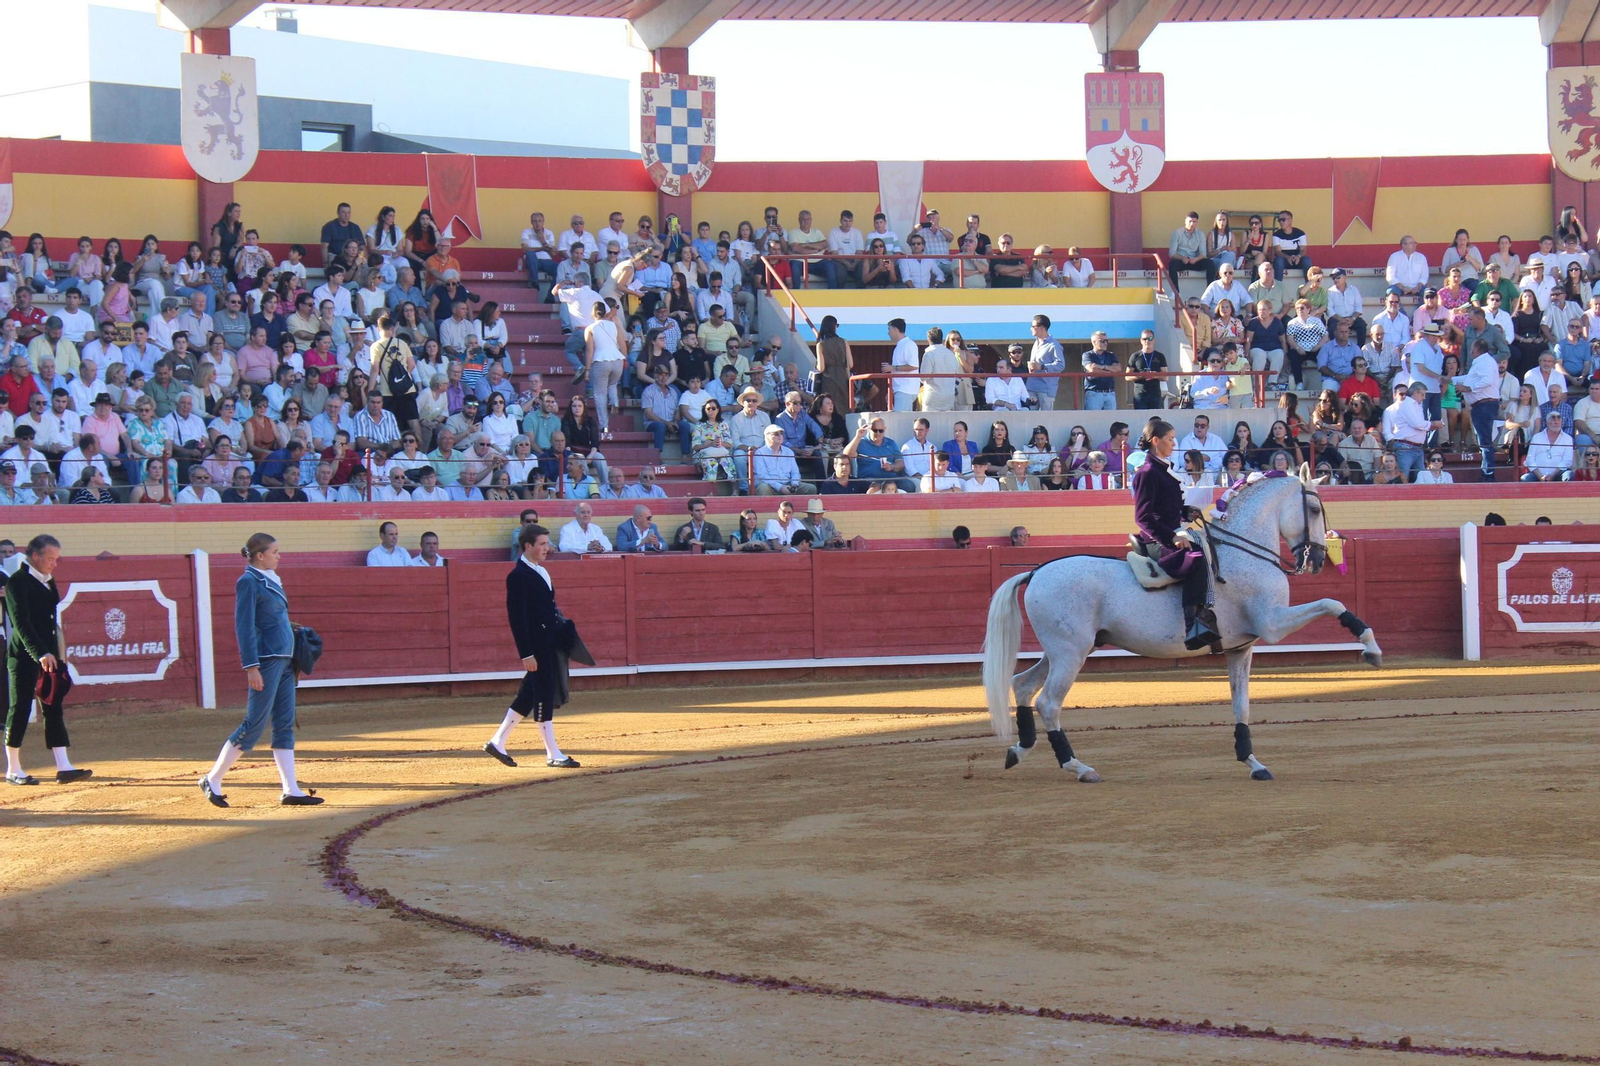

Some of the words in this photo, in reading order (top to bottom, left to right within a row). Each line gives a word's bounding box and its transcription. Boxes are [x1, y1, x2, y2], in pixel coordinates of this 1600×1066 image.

[482, 272, 494, 280] F9
[528, 335, 540, 343] F7
[549, 366, 563, 374] F6
[600, 433, 614, 441] F4
[1510, 594, 1549, 605] PALOS
[1551, 594, 1568, 604] DE
[1570, 594, 1585, 604] LA
[66, 644, 104, 658] PALOS
[106, 643, 123, 656] DE
[124, 643, 139, 655] LA
